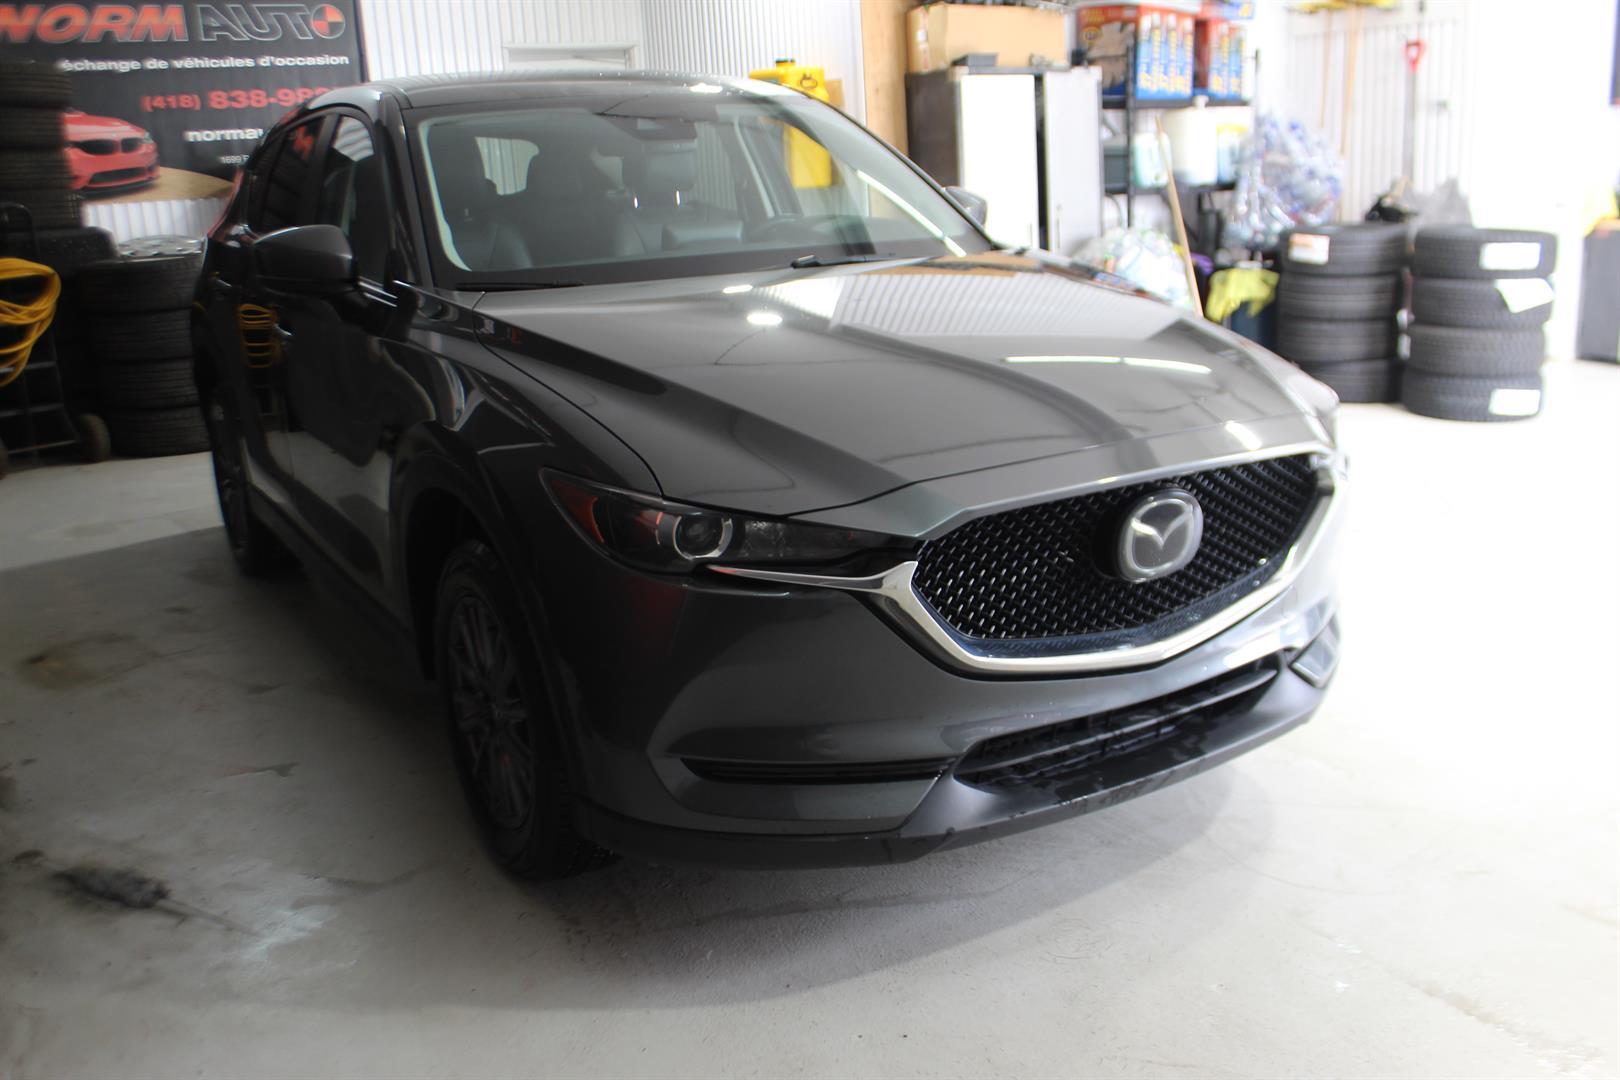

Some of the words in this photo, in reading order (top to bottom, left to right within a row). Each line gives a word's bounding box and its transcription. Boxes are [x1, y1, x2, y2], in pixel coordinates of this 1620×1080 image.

[0, 4, 189, 43] NORM
[61, 58, 141, 72] échange
[144, 57, 169, 69] de
[173, 56, 255, 69] véhicules
[259, 54, 350, 67] d'occasion
[142, 94, 201, 112] (418)
